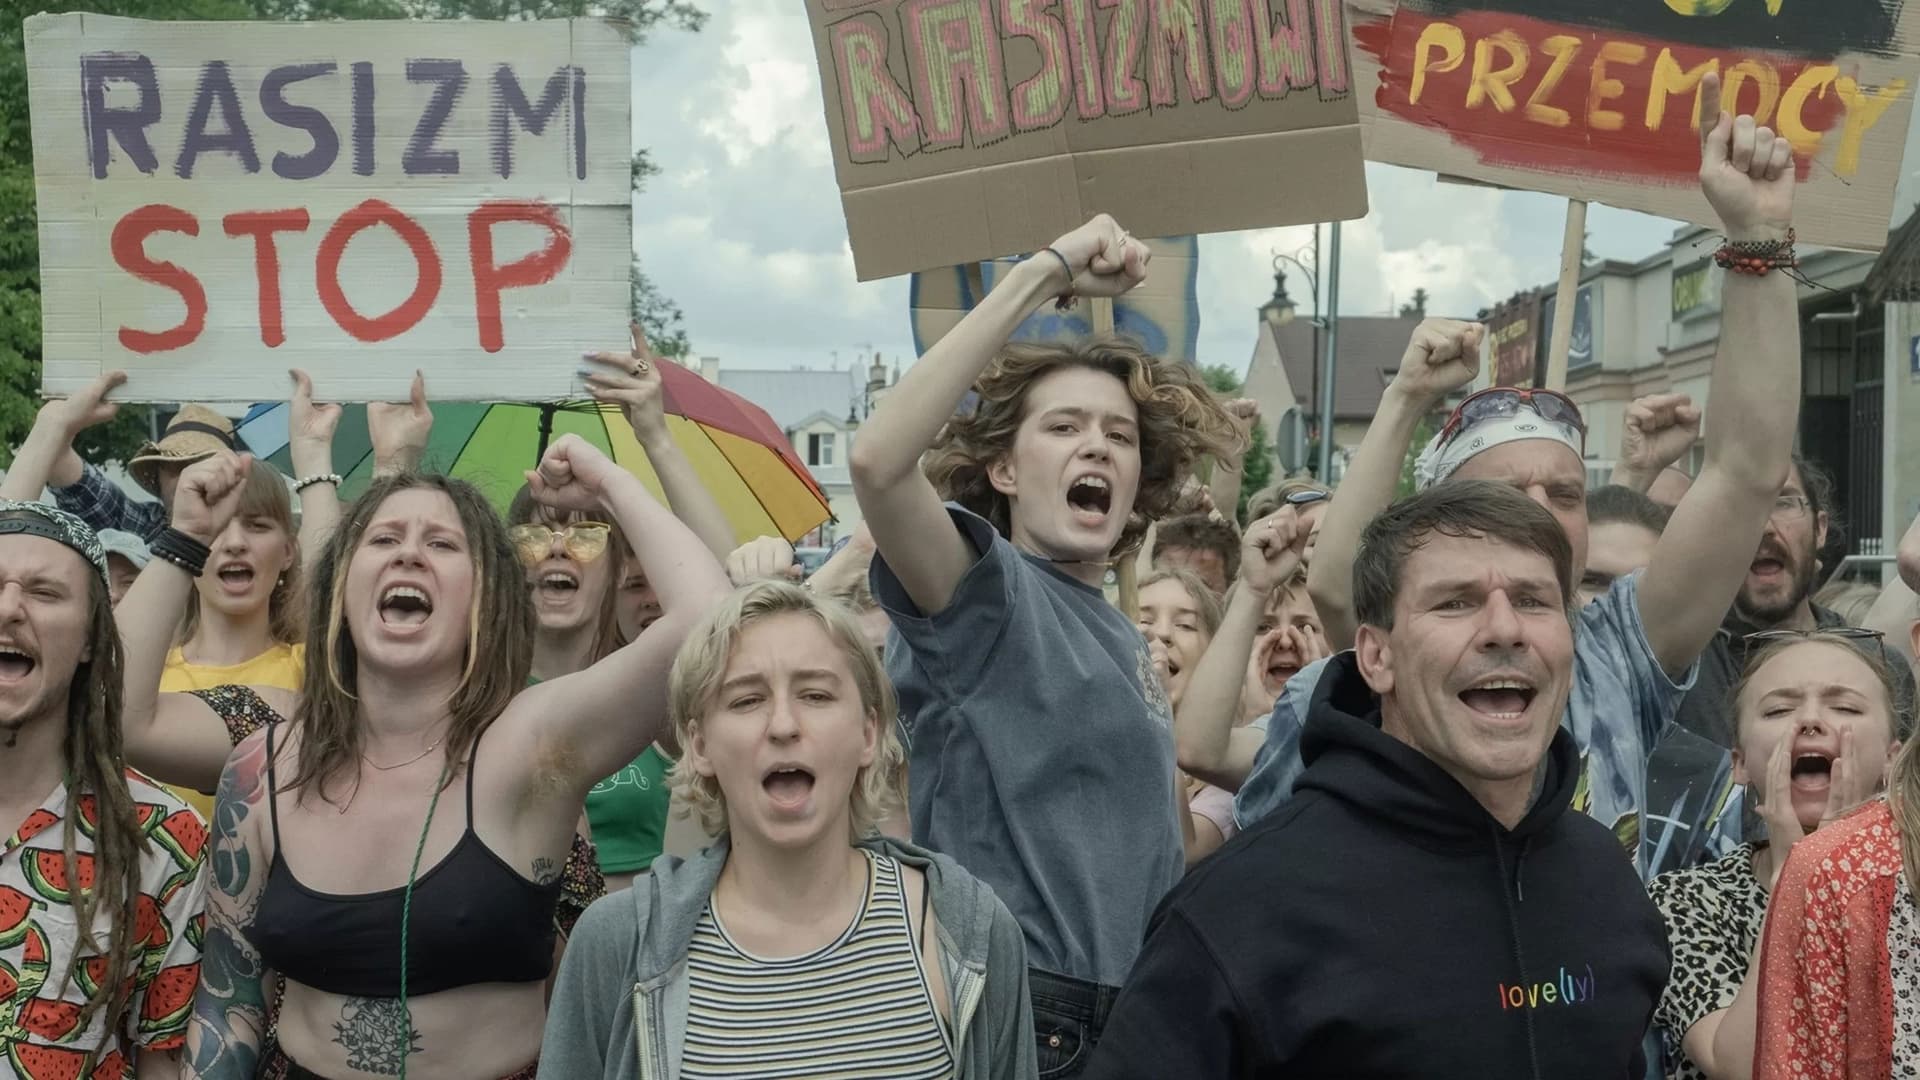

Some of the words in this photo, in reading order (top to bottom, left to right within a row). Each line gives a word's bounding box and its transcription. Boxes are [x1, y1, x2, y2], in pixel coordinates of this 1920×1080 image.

[80, 51, 586, 180] RASIZM
[825, 0, 1348, 163] RASIZMOWI
[1409, 22, 1906, 175] PRZEMOCY
[110, 198, 572, 353] STOP
[1499, 963, 1595, 1009] love(ly)
